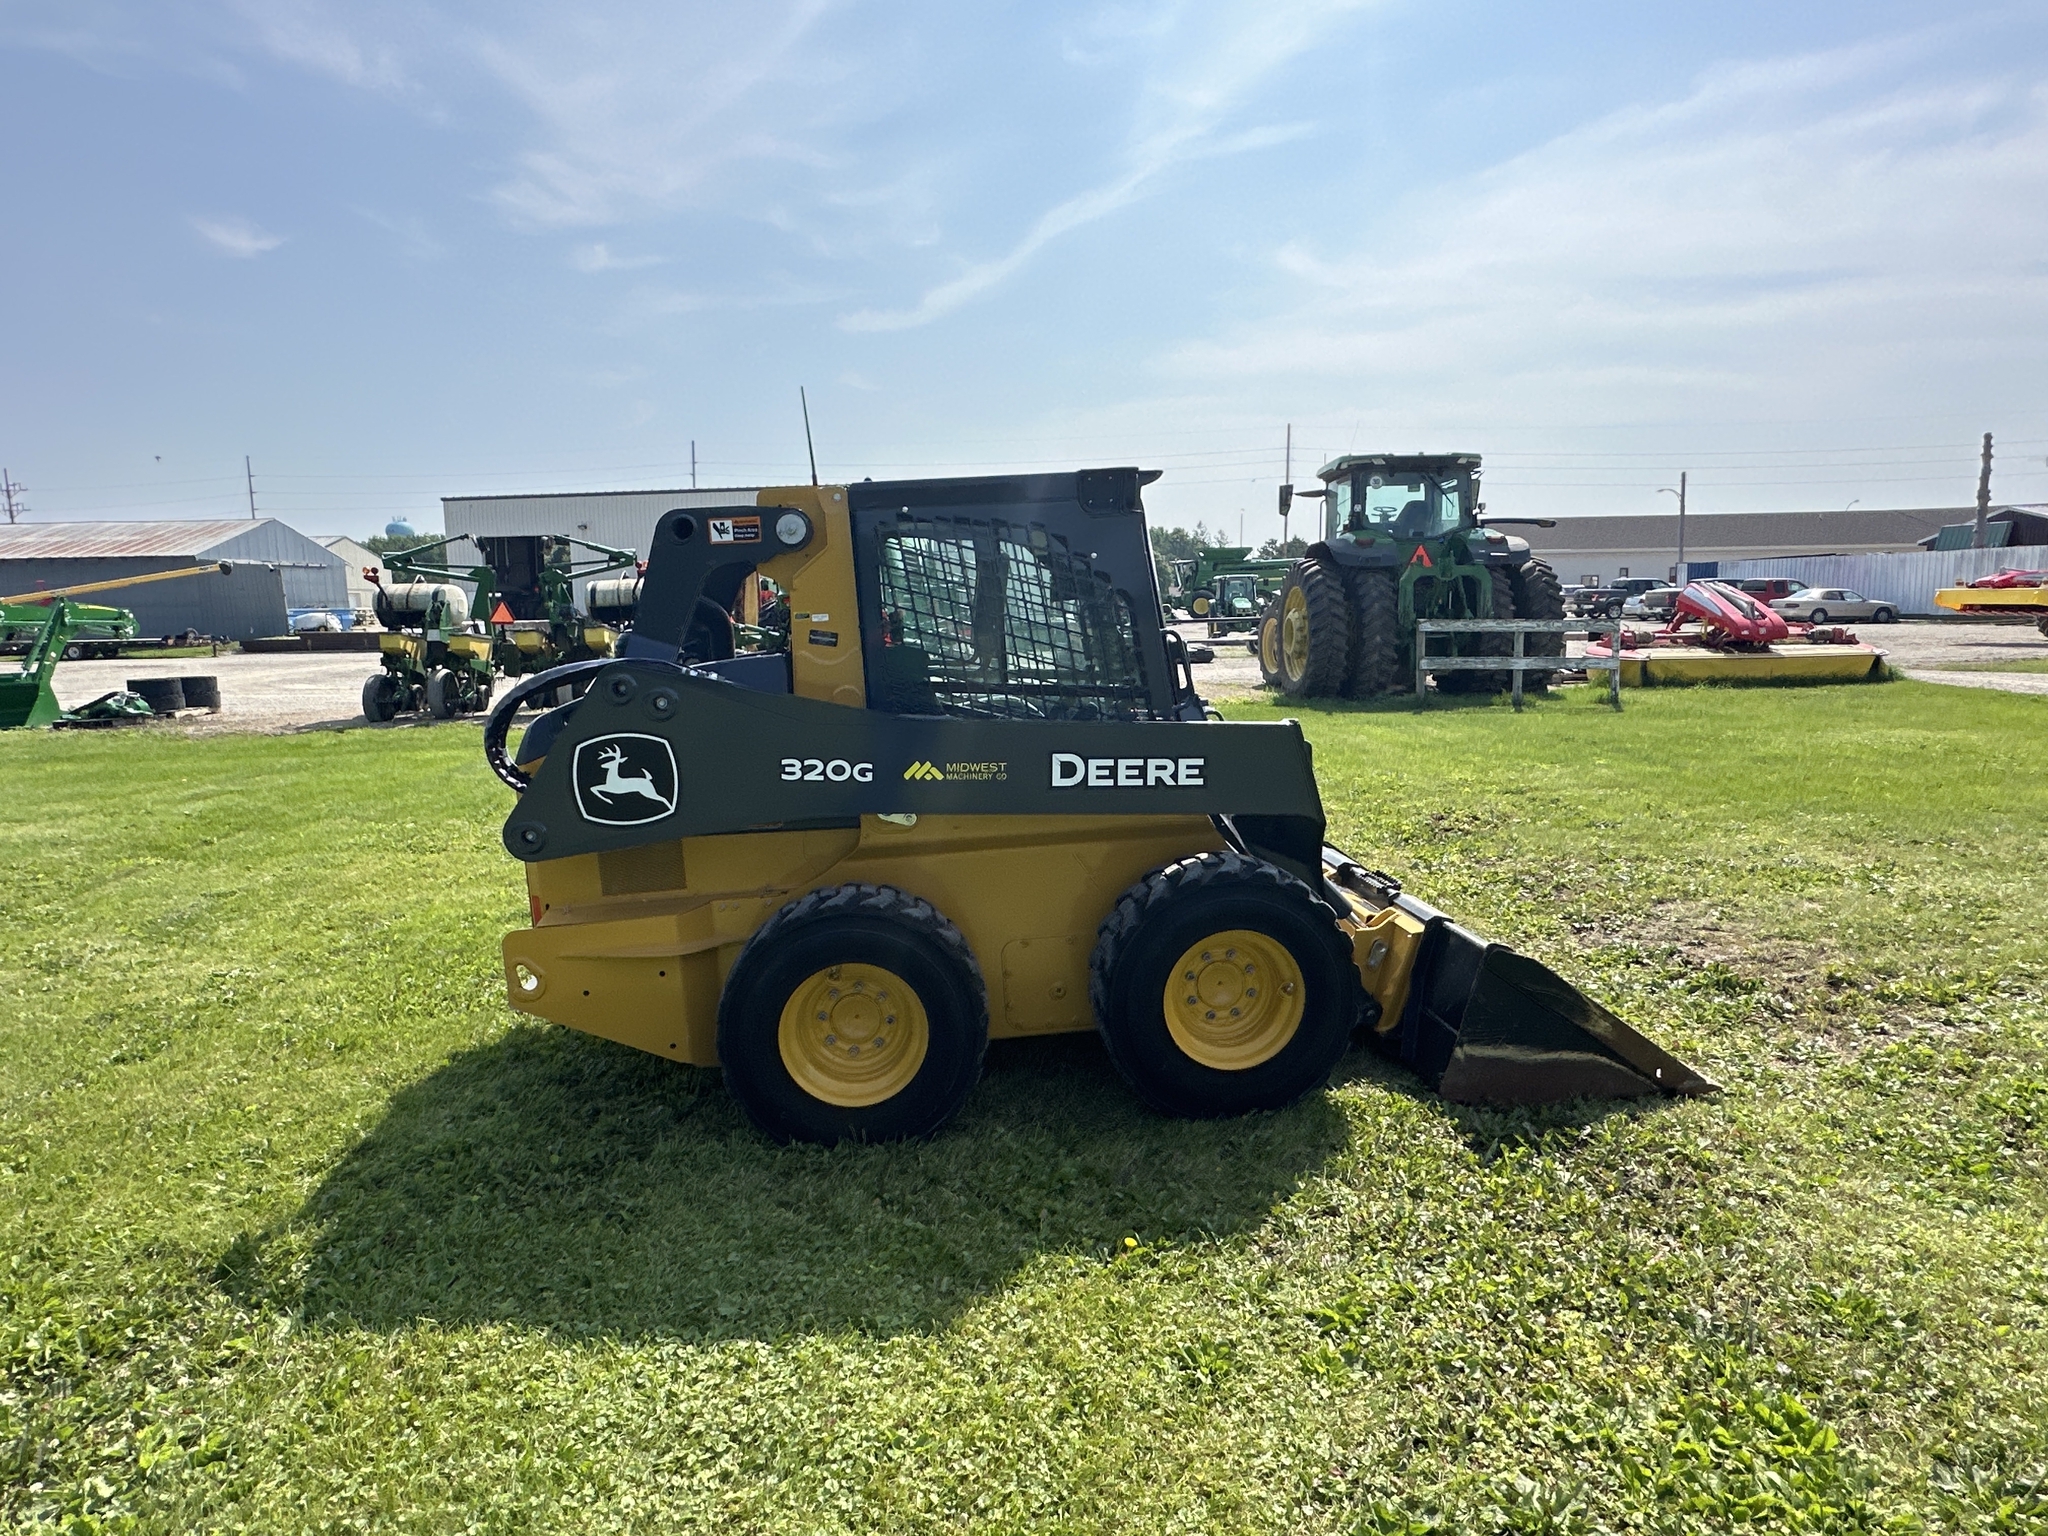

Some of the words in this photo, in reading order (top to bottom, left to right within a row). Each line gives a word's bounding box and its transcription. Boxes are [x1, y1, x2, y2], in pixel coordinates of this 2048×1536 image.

[780, 758, 874, 782] 320G
[946, 762, 1008, 772] MIDWEST
[1051, 753, 1205, 787] DEERE
